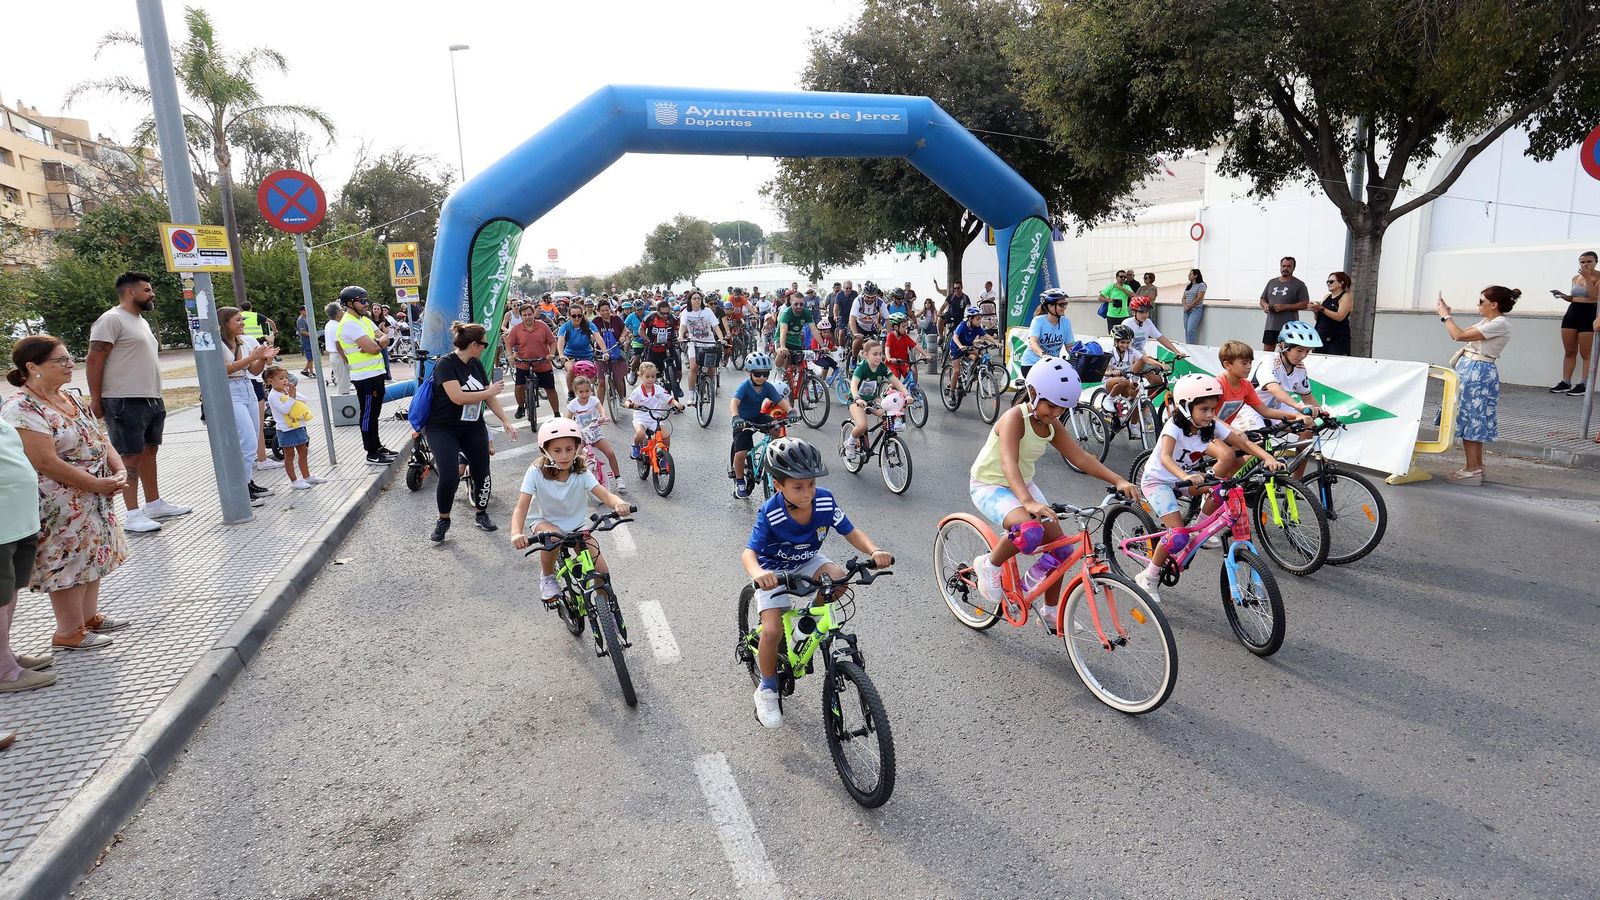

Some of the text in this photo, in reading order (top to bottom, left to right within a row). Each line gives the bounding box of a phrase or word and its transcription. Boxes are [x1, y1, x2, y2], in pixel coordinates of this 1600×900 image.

[685, 117, 753, 128] Deportes
[686, 105, 901, 122] Ayuntamiento de Jerez
[1010, 232, 1043, 317] El Corte Inglés
[483, 281, 502, 318] Corte
[1040, 333, 1063, 344] Nike
[479, 475, 491, 507] adidas
